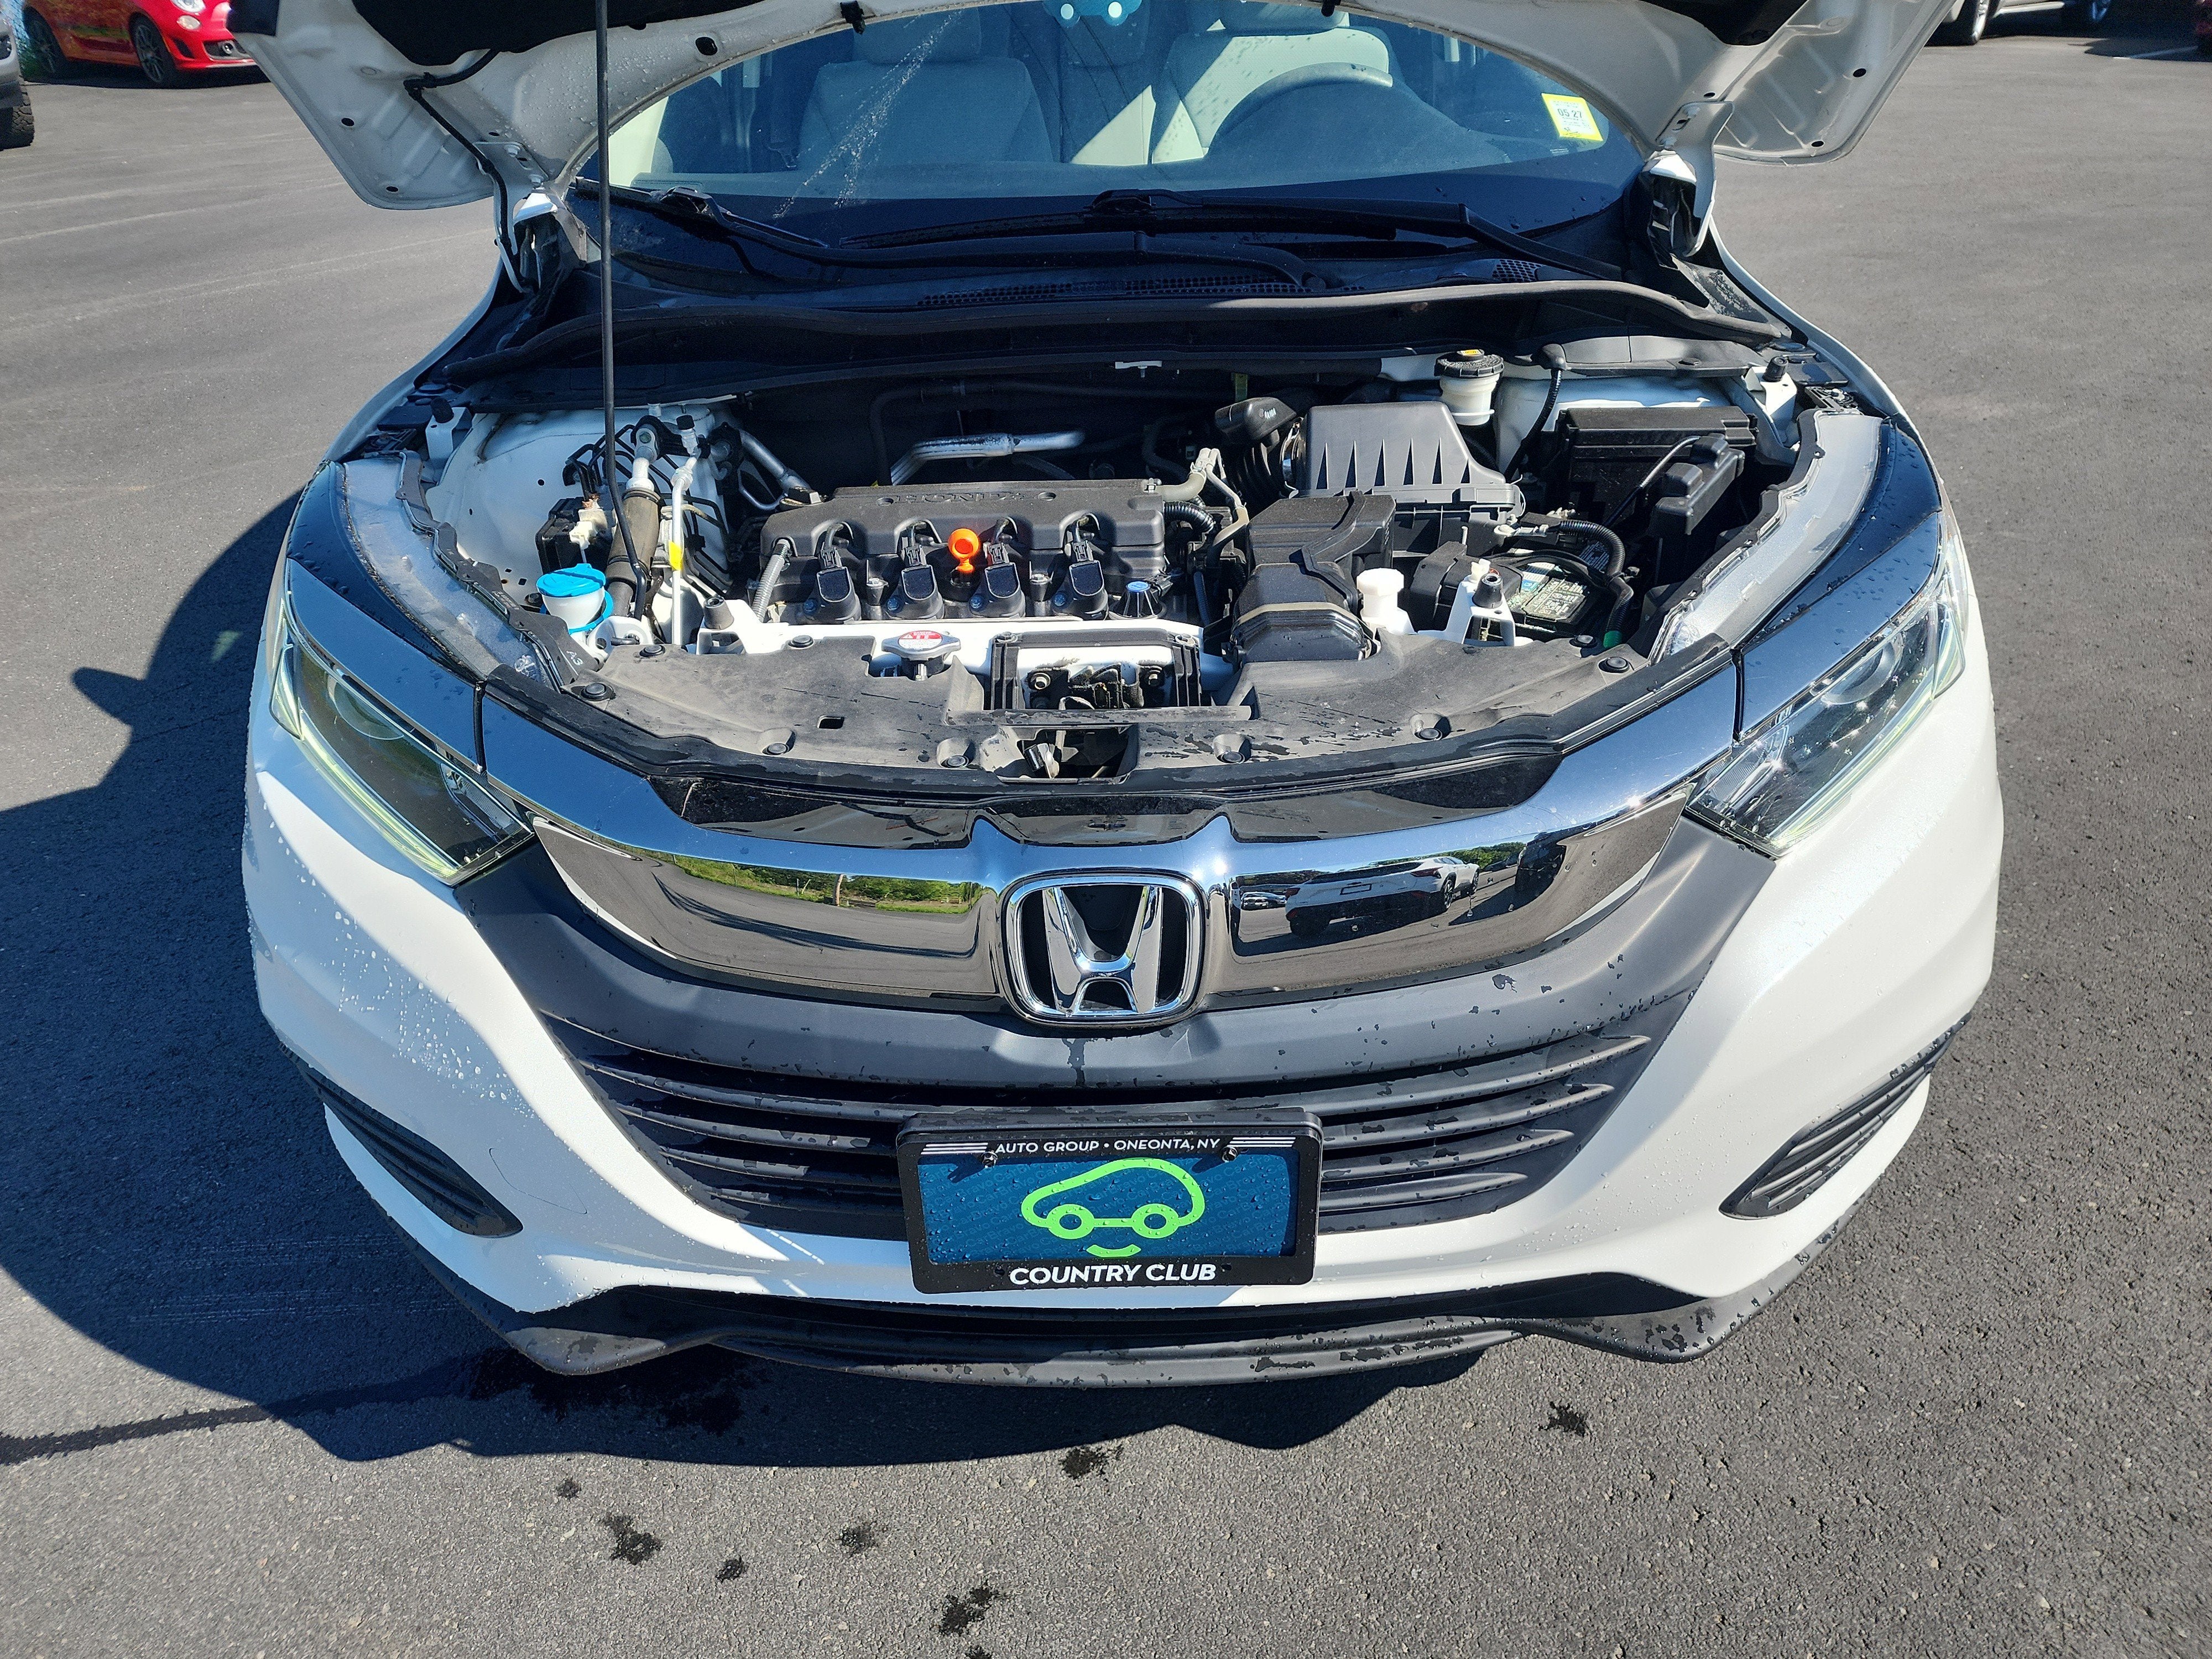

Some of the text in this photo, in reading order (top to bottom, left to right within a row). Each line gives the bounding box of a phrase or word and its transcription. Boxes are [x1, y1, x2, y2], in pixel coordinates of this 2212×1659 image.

[1557, 108, 1582, 118] 05 27
[995, 1143, 1039, 1153] AUTO
[1044, 1141, 1099, 1152] GROUP
[1197, 1139, 1220, 1149] NY
[1010, 1264, 1216, 1285] COUNTRY CLUB
